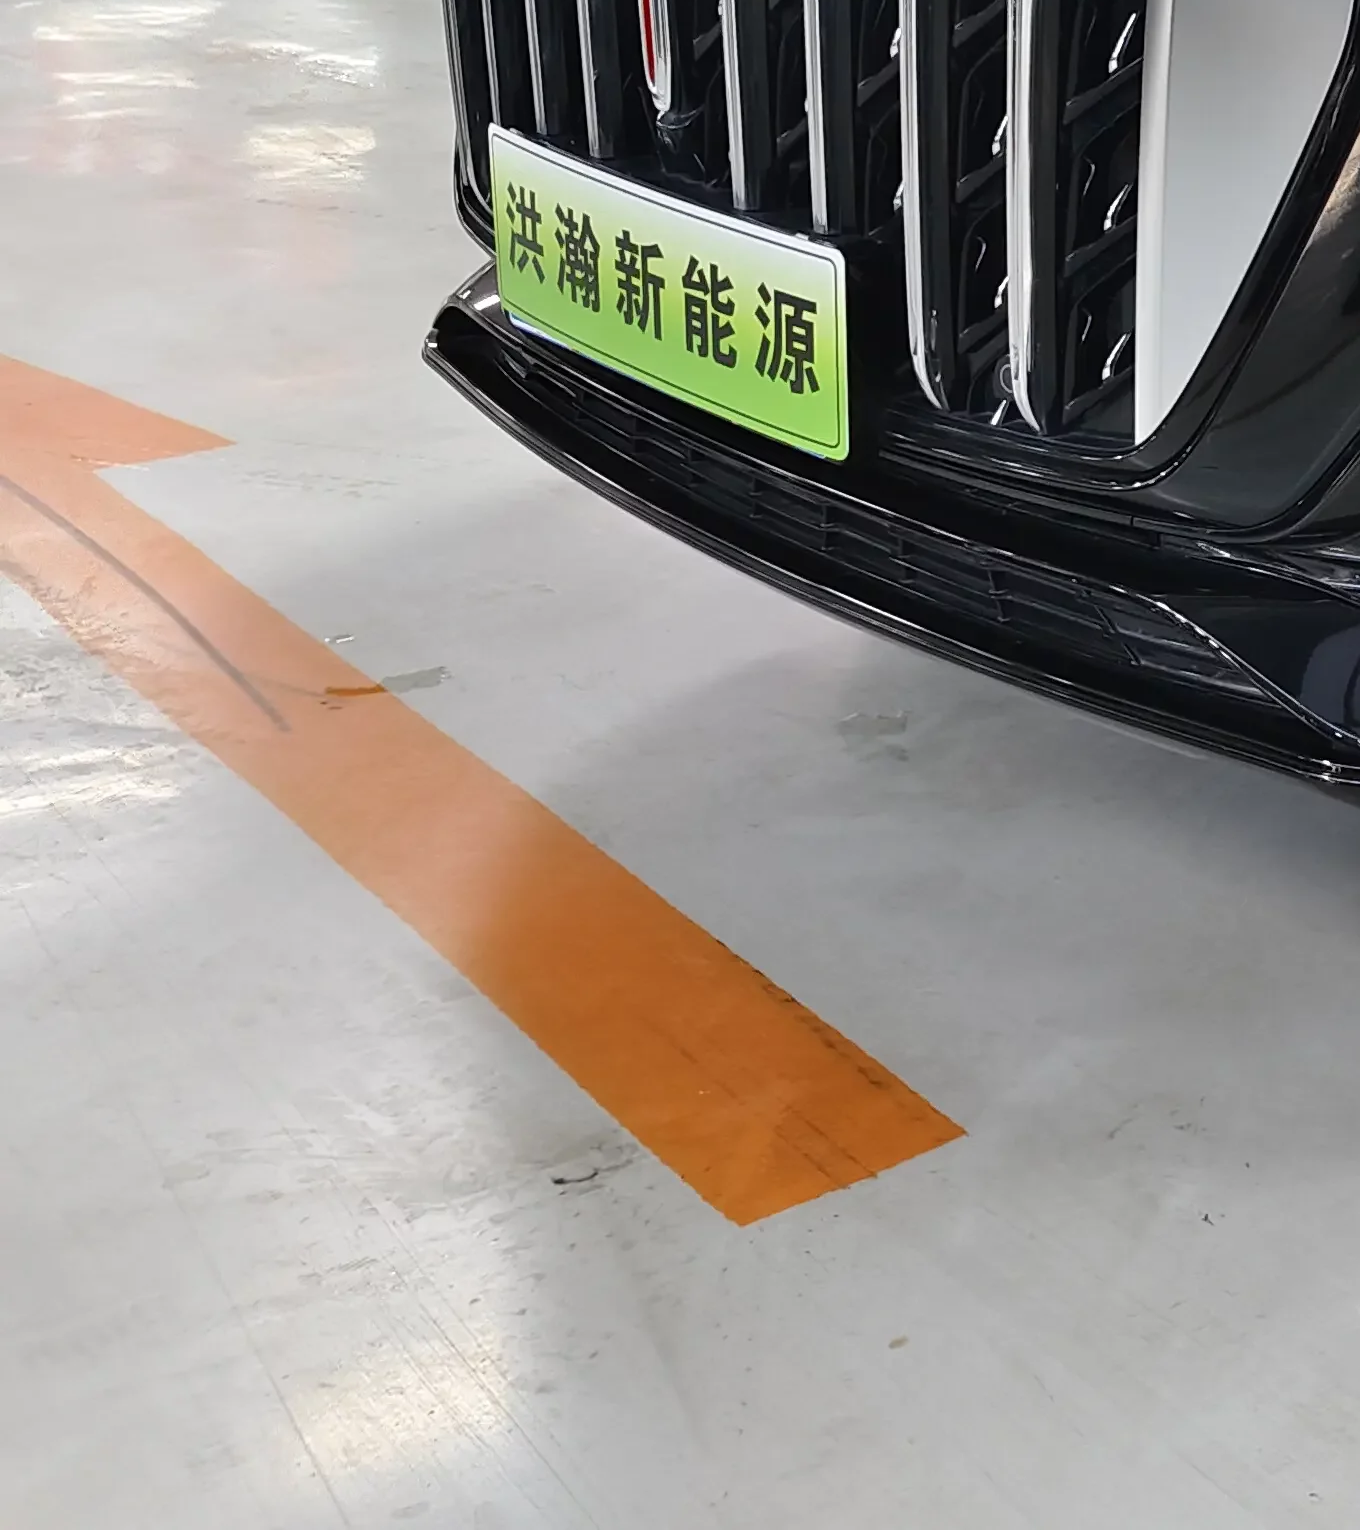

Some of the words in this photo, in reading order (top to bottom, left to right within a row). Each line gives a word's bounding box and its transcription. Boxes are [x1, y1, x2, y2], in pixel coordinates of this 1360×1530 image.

[506, 181, 821, 395] 洪瀚新能源
